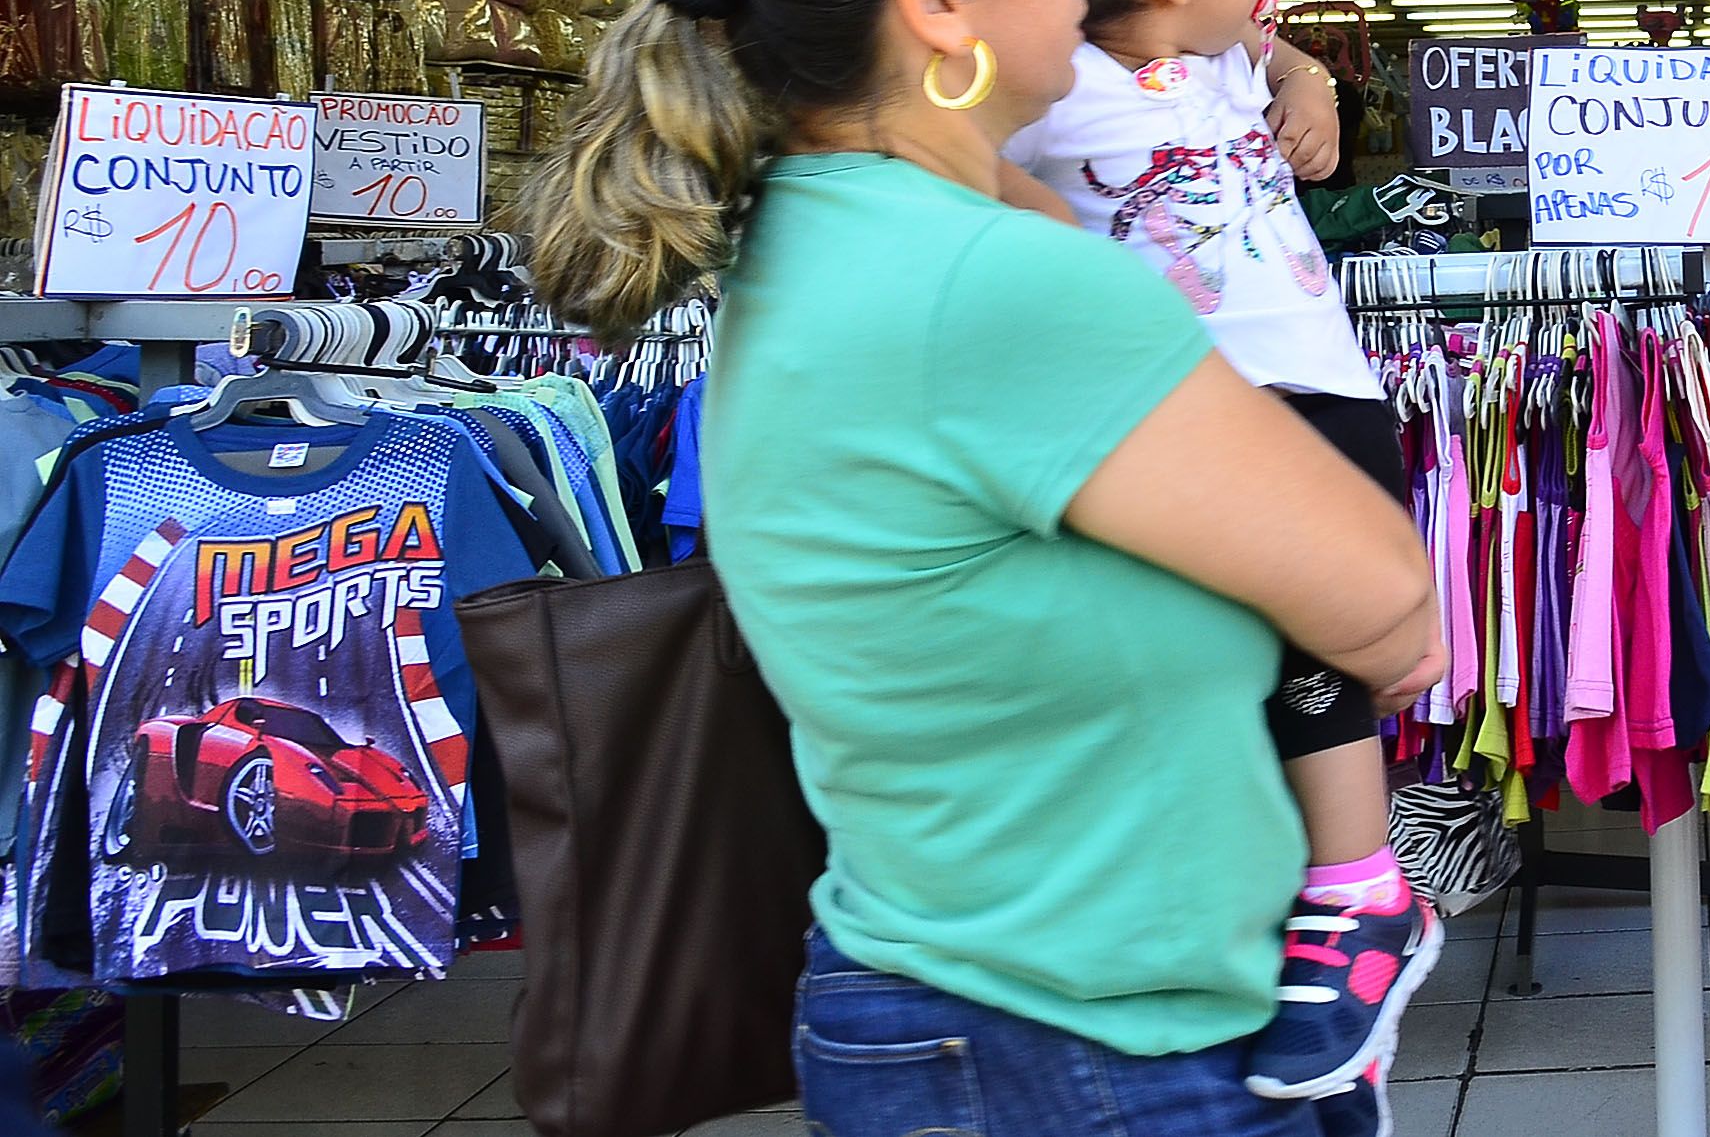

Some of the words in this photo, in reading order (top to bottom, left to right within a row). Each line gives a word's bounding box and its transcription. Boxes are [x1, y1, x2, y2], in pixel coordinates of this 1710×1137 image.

[1429, 107, 1528, 157] BLA
[72, 153, 303, 198] CONJUNTO
[349, 157, 362, 170] A
[1535, 148, 1603, 179] POR
[1535, 190, 1639, 224] APENAS
[195, 501, 443, 628] MEGA
[219, 565, 444, 687] SPORTS
